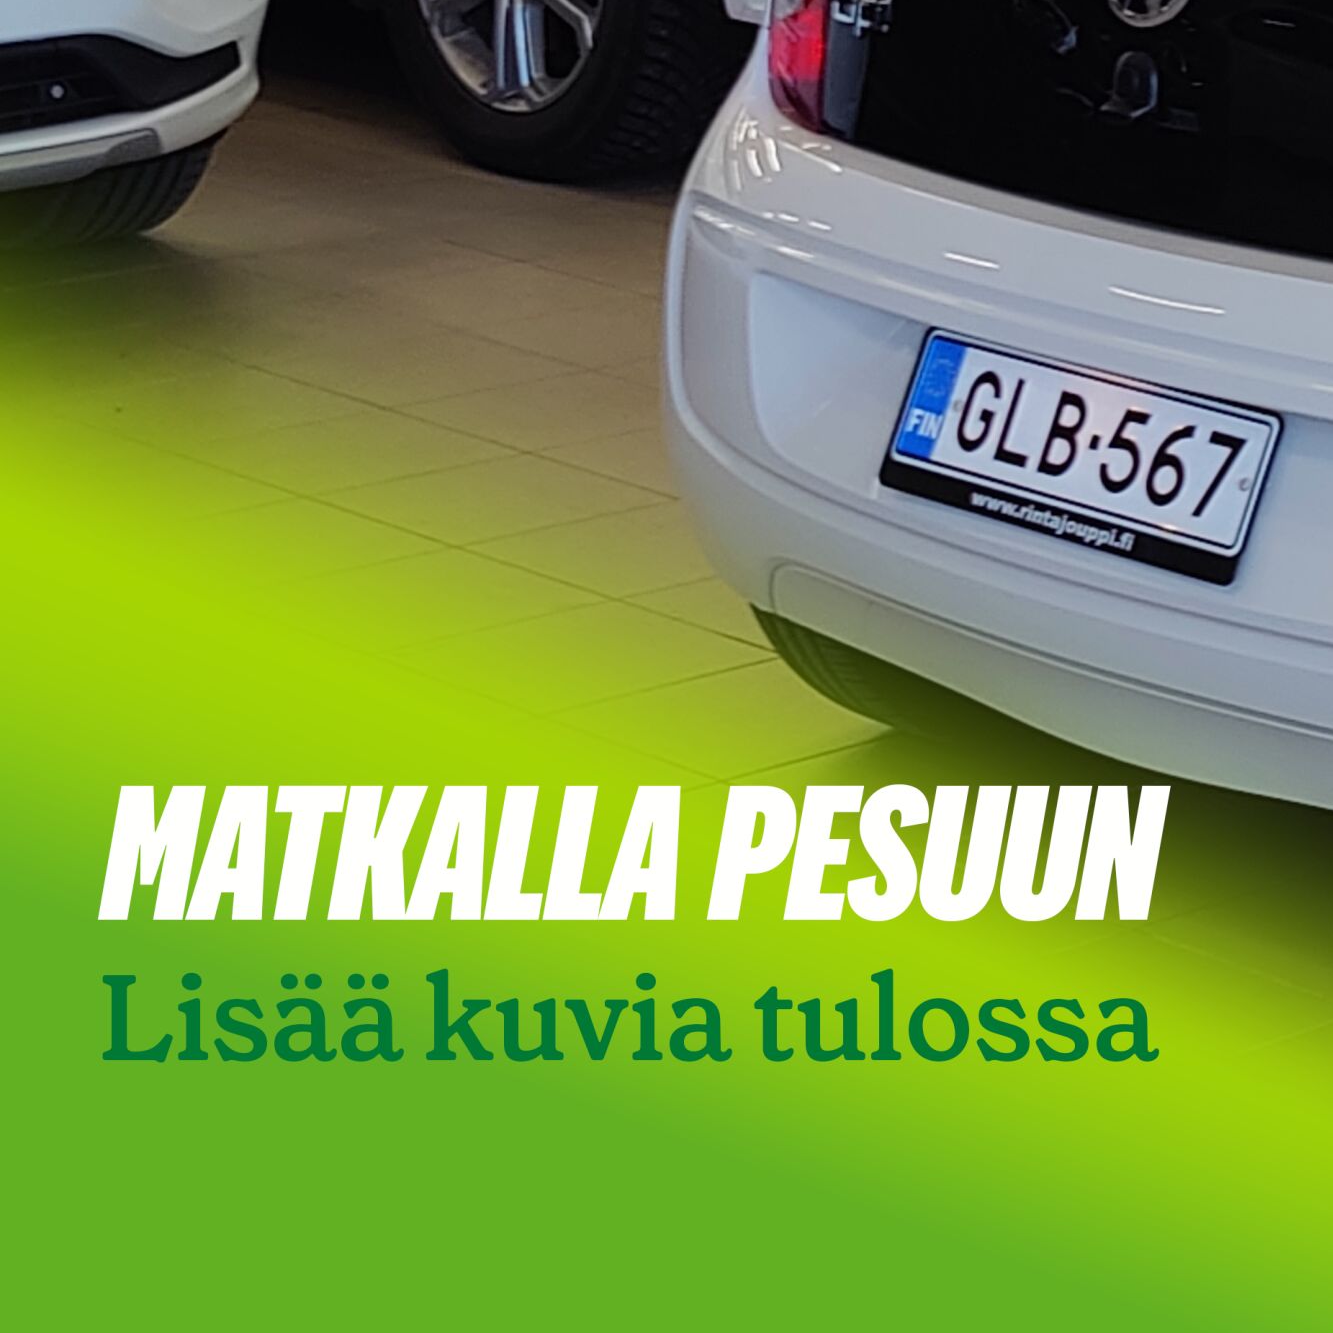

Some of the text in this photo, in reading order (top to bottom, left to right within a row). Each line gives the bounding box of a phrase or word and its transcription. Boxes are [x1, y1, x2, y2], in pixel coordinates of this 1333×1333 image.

[908, 408, 943, 440] FIN
[957, 370, 1247, 517] GLB-567
[969, 491, 1136, 553] www.rintajouppi.fi
